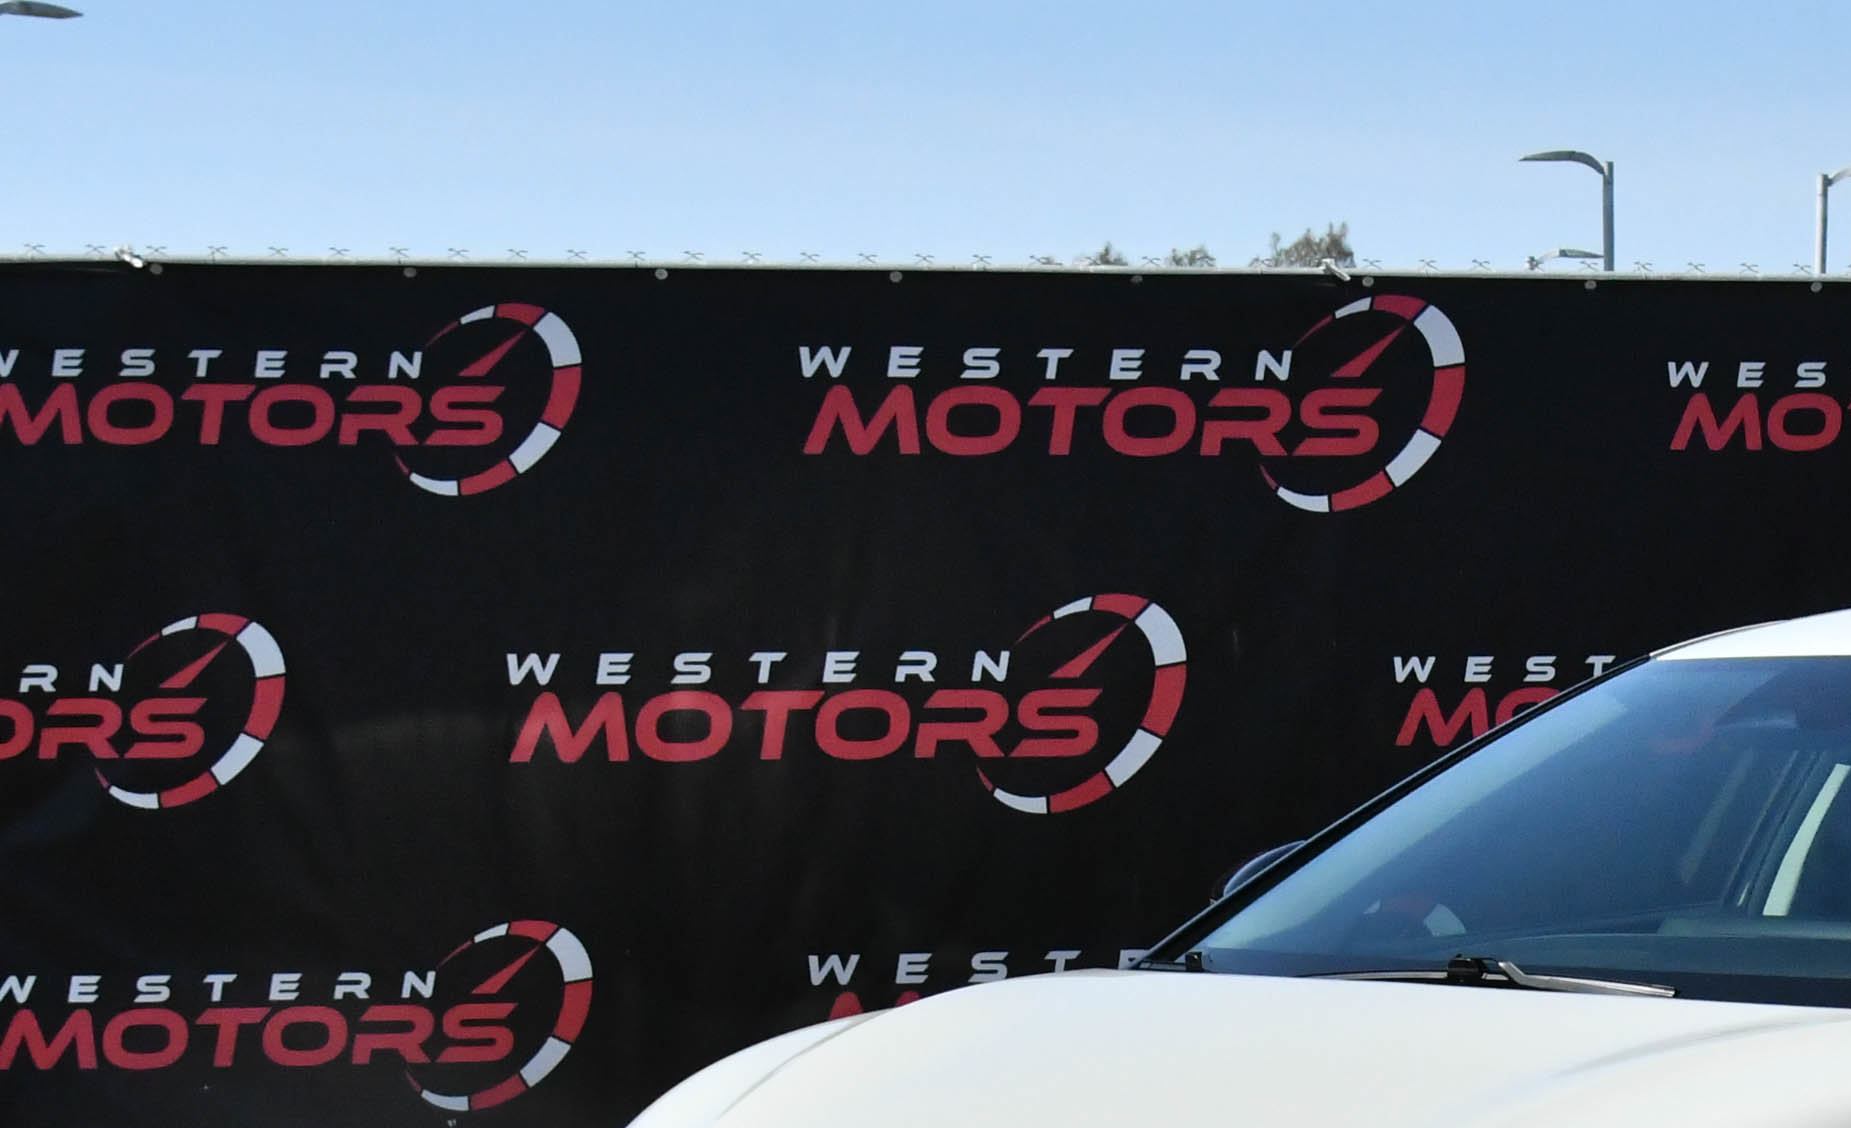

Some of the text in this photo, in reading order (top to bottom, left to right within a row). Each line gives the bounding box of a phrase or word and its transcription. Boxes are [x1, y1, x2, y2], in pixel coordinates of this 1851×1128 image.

[799, 346, 1293, 380] WESTERN
[0, 382, 505, 446] MOTORS
[803, 383, 1382, 457] MOTORS
[506, 651, 1011, 685] WESTERN
[509, 688, 1102, 763] MOTORS
[0, 971, 436, 1004] WESTERN
[0, 1004, 517, 1070] MOTORS
